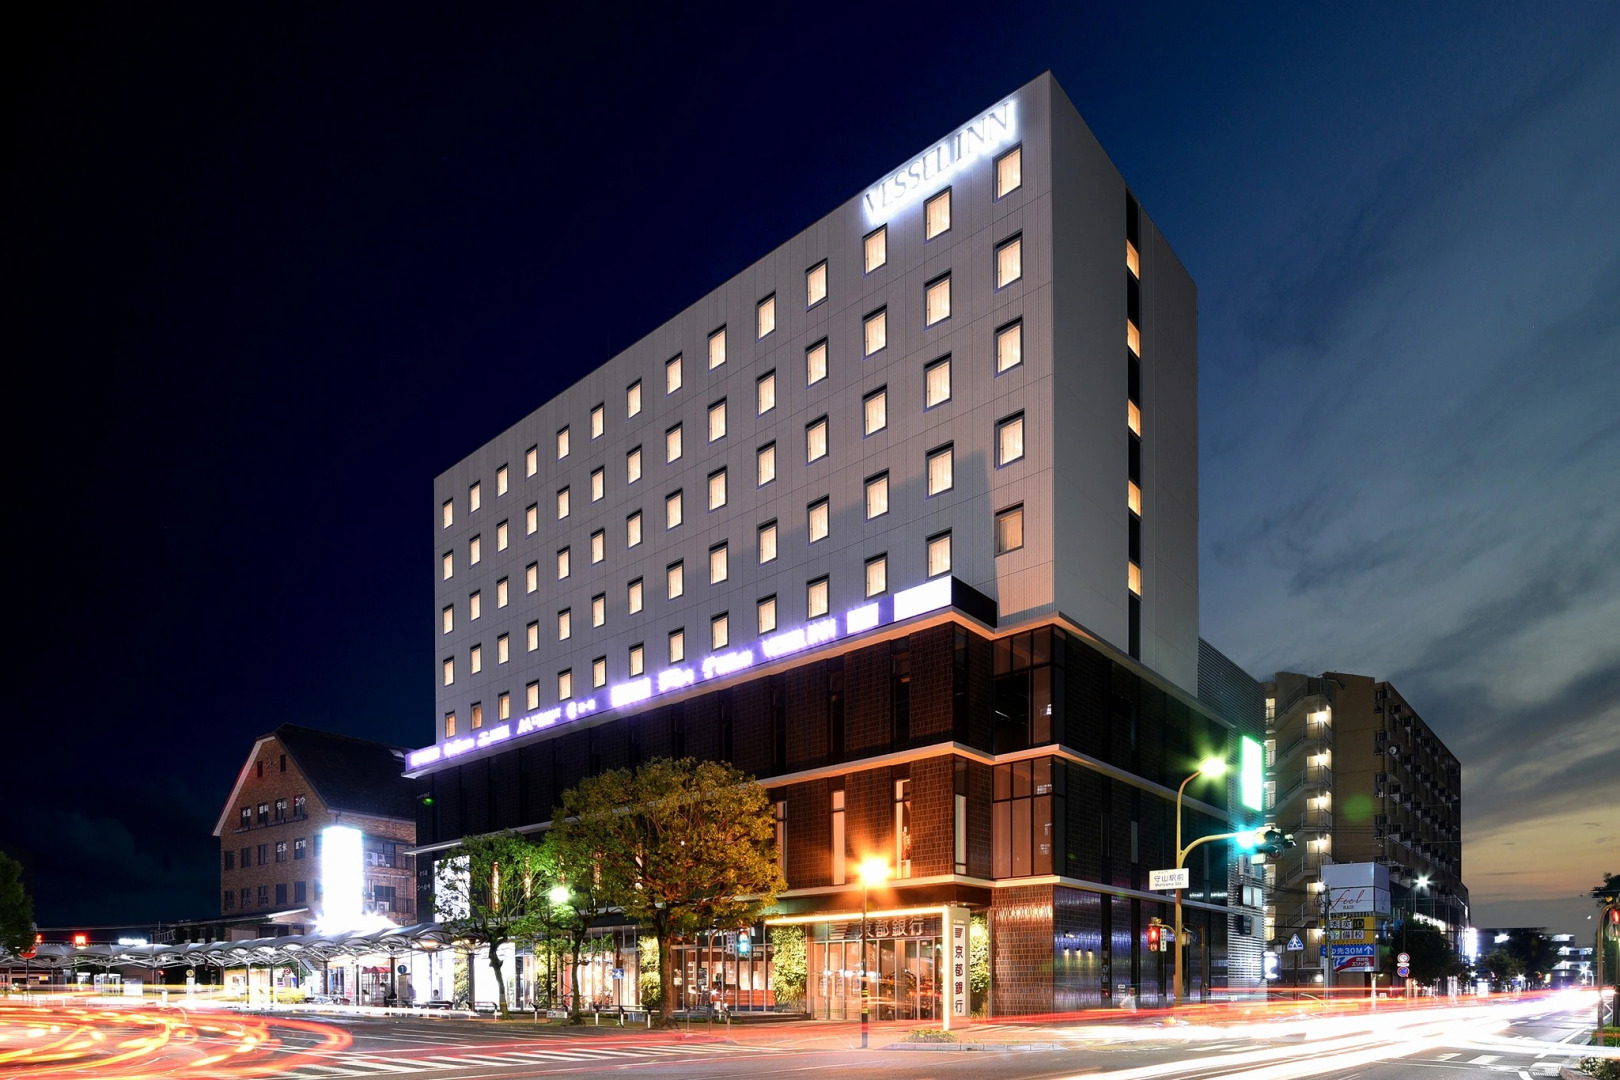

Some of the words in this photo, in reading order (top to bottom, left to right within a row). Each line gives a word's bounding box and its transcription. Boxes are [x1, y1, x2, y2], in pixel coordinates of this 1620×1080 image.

[864, 146, 950, 213] VESSEL
[956, 103, 1010, 161] INN
[1154, 873, 1184, 883] 守山駅前
[858, 917, 925, 938] 京都銀行
[954, 945, 964, 1013] 京都銀行
